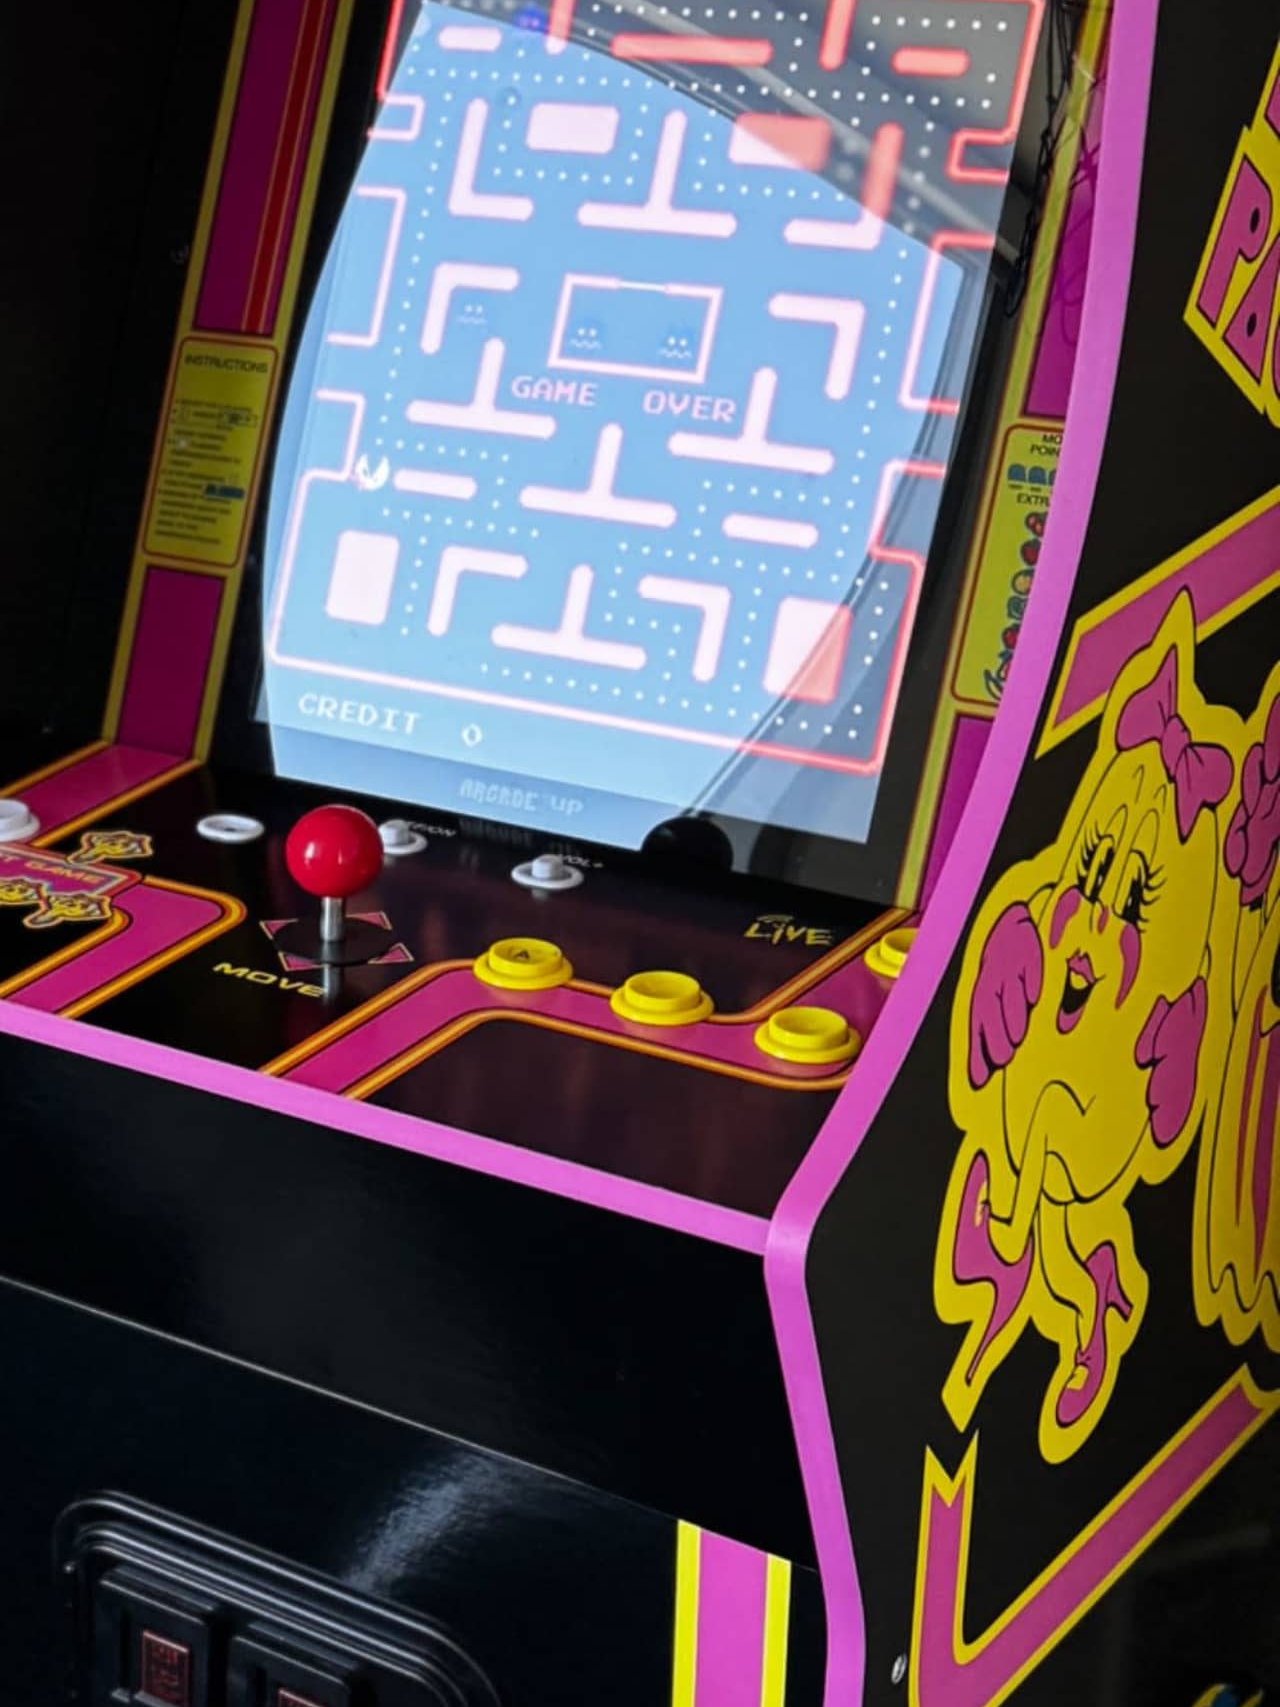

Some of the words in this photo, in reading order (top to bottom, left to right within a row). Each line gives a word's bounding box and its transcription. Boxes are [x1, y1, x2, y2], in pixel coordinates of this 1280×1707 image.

[184, 353, 269, 375] INSTRUCTIONS
[511, 375, 598, 407] GAME
[643, 389, 737, 423] OVER
[297, 692, 421, 735] CREDIT
[212, 962, 326, 998] MOVE
